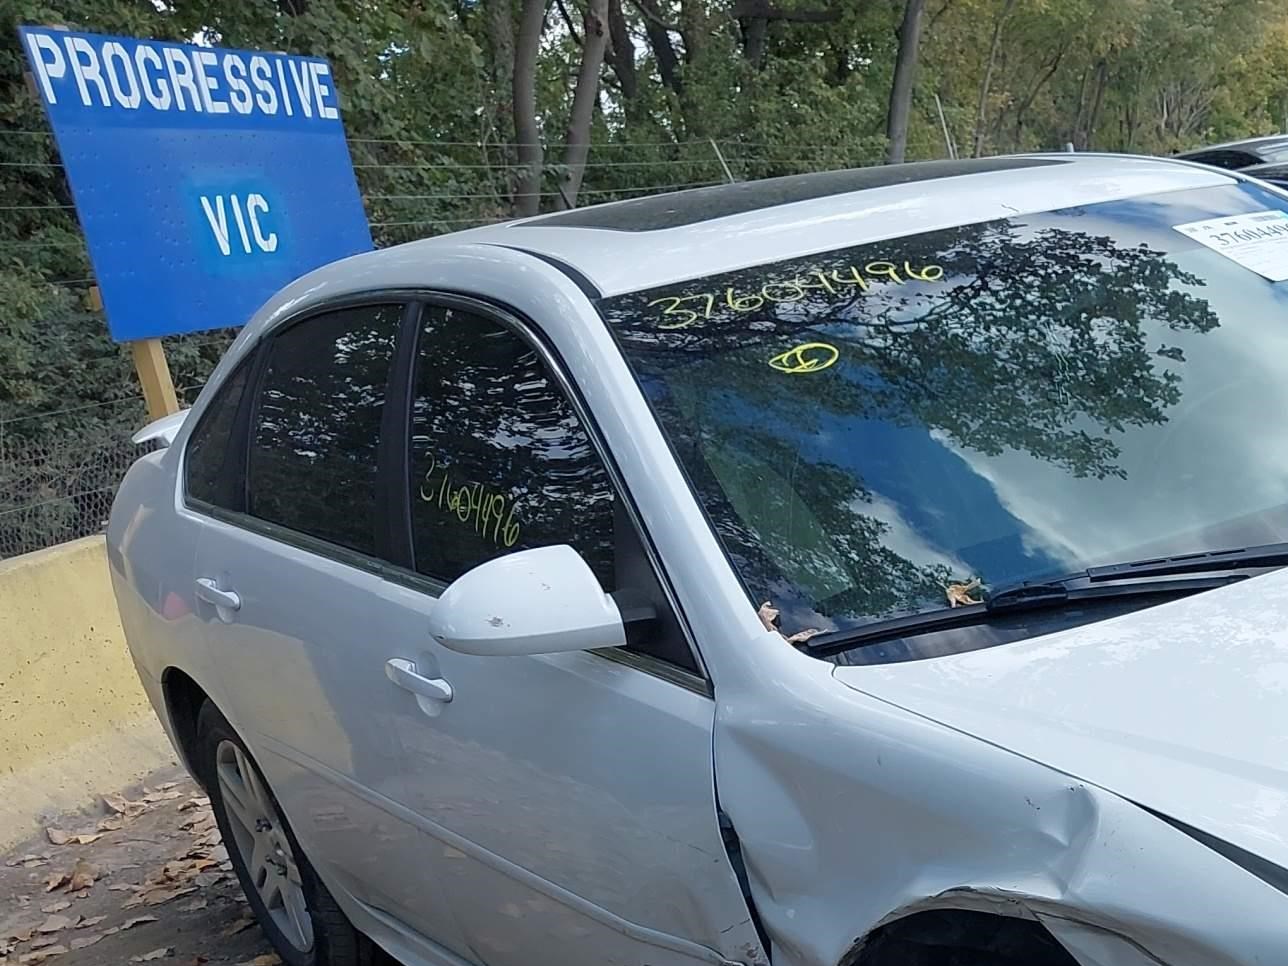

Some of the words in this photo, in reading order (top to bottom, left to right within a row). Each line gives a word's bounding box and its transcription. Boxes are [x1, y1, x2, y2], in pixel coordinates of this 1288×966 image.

[26, 32, 340, 120] PROGRESSIVE
[200, 193, 279, 256] VIC
[649, 261, 944, 330] 37604496
